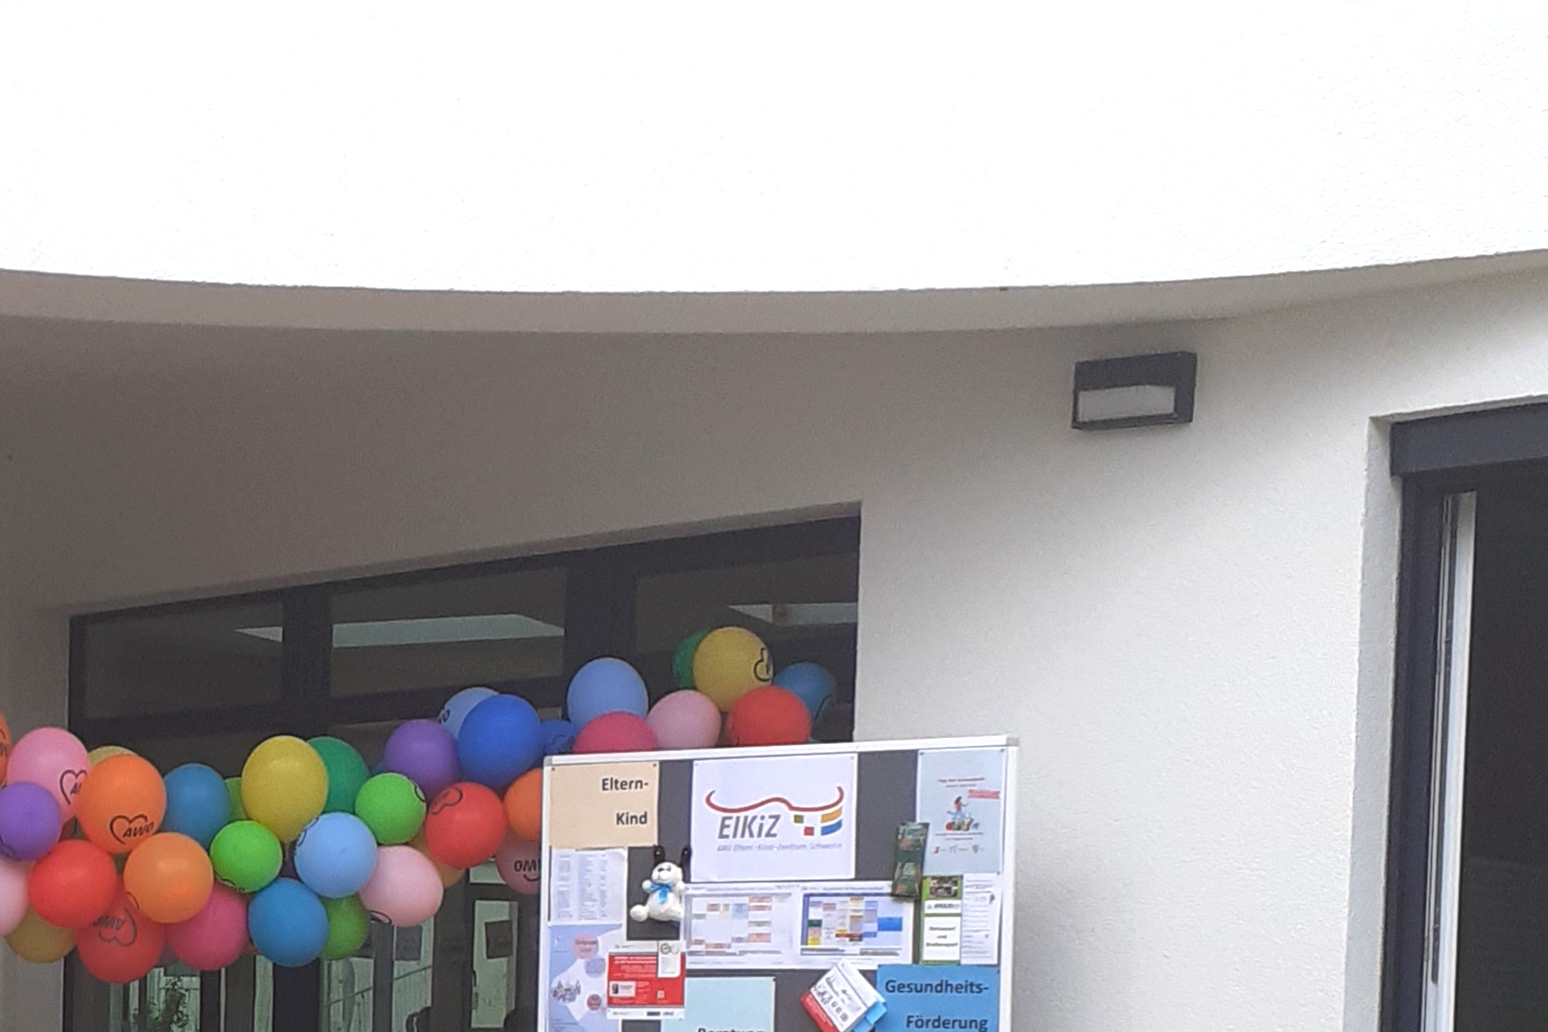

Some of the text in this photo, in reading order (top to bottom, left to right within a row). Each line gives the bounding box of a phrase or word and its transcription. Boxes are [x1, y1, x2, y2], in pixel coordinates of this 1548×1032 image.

[601, 776, 649, 791] Eltern-
[615, 811, 648, 826] Kind
[122, 821, 155, 838] AWO
[885, 979, 989, 994] Gesundheits-
[906, 1015, 989, 1032] Förderung
